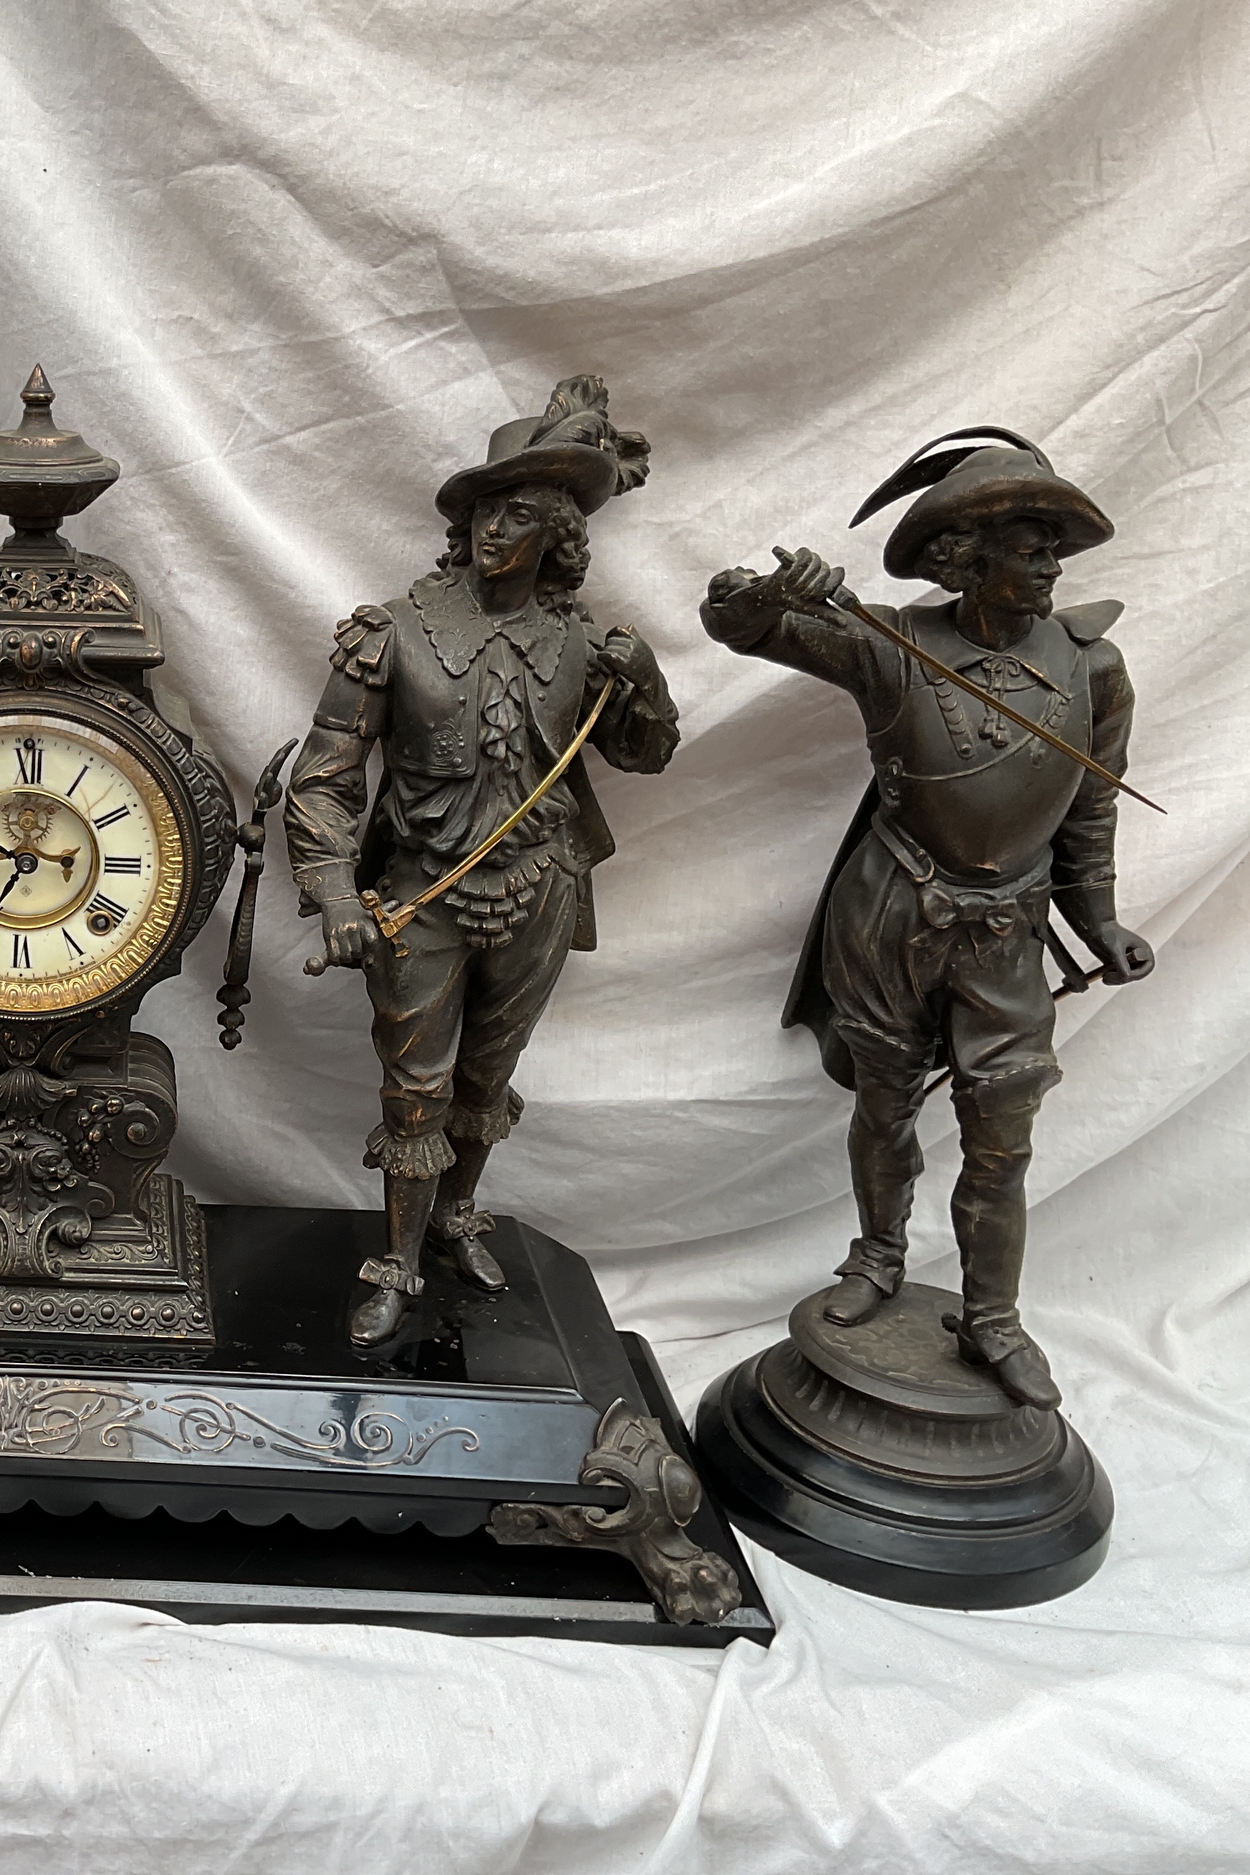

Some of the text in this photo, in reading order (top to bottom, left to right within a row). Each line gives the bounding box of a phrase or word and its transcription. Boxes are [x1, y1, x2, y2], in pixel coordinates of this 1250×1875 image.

[13, 748, 45, 786] XII
[64, 764, 91, 799] I
[91, 803, 131, 832] II
[103, 854, 142, 877] III
[10, 934, 33, 969] VI
[61, 927, 86, 961] V
